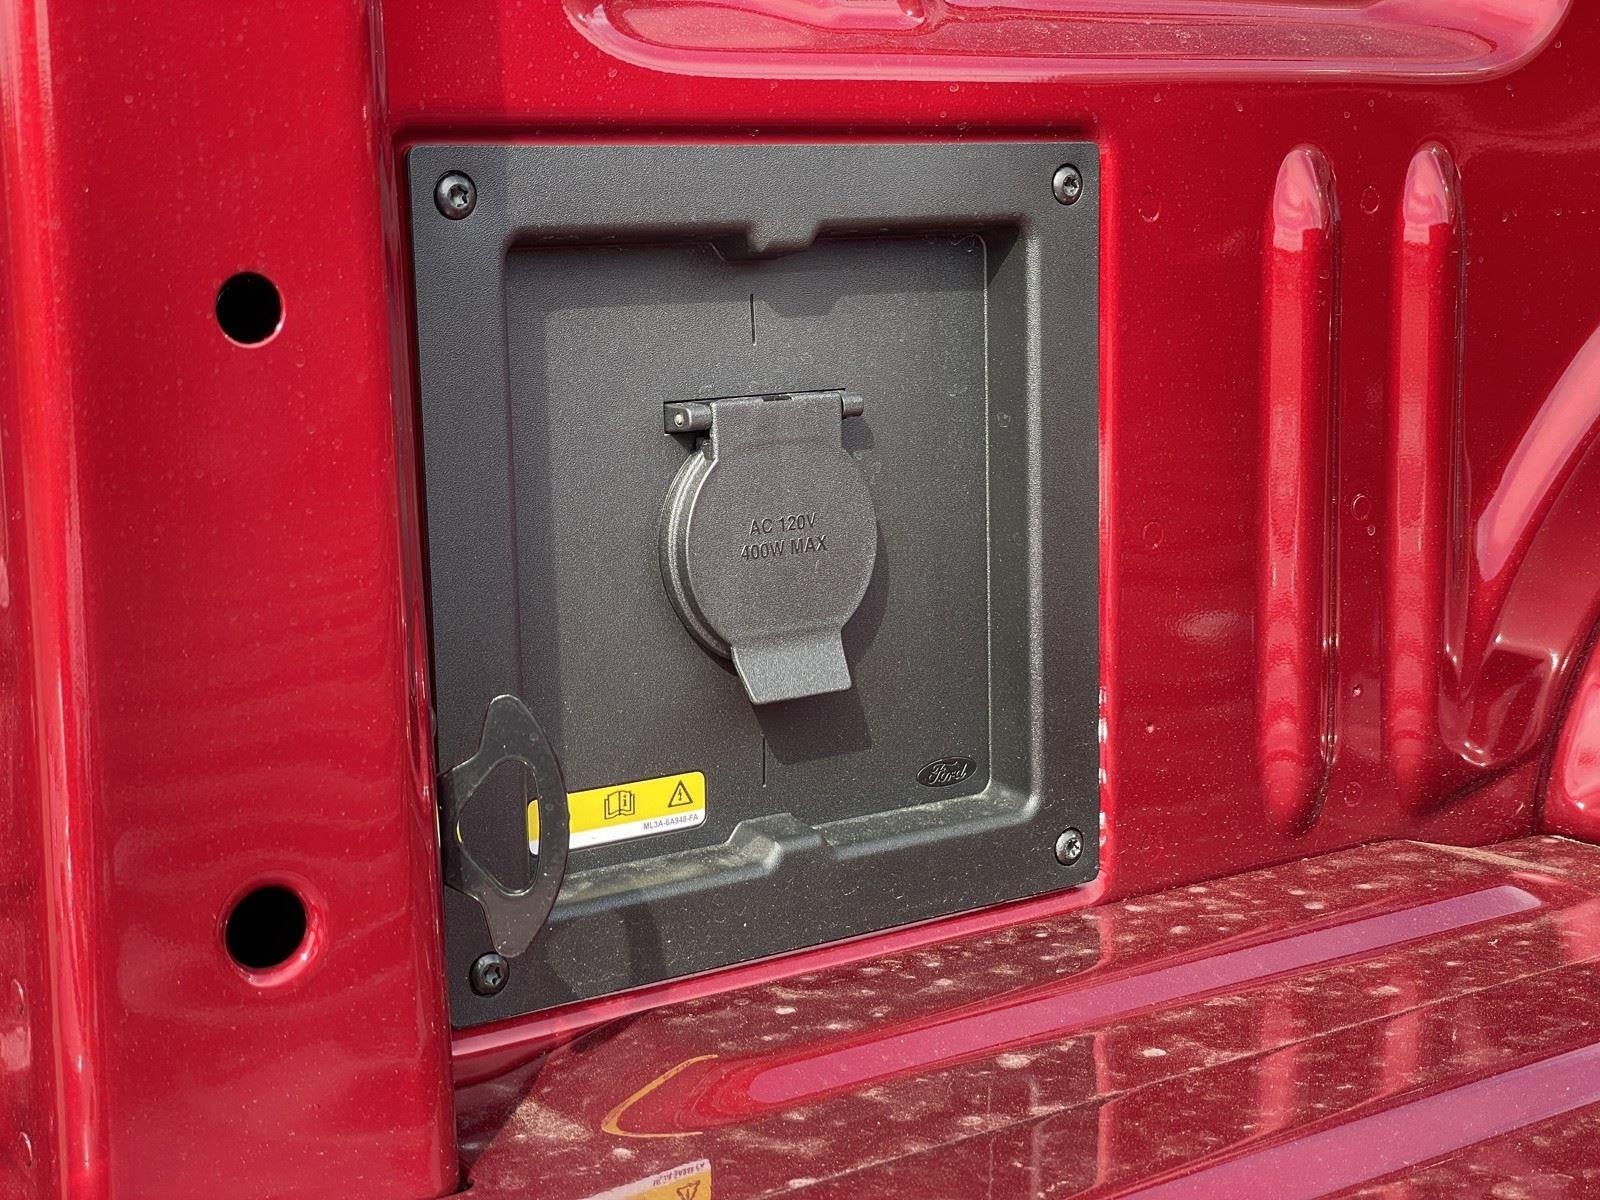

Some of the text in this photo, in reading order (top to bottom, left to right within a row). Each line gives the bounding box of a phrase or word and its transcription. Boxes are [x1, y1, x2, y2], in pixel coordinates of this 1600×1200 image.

[748, 512, 818, 536] AC 120V
[740, 534, 828, 561] 400W MAX
[927, 761, 968, 785] Ford
